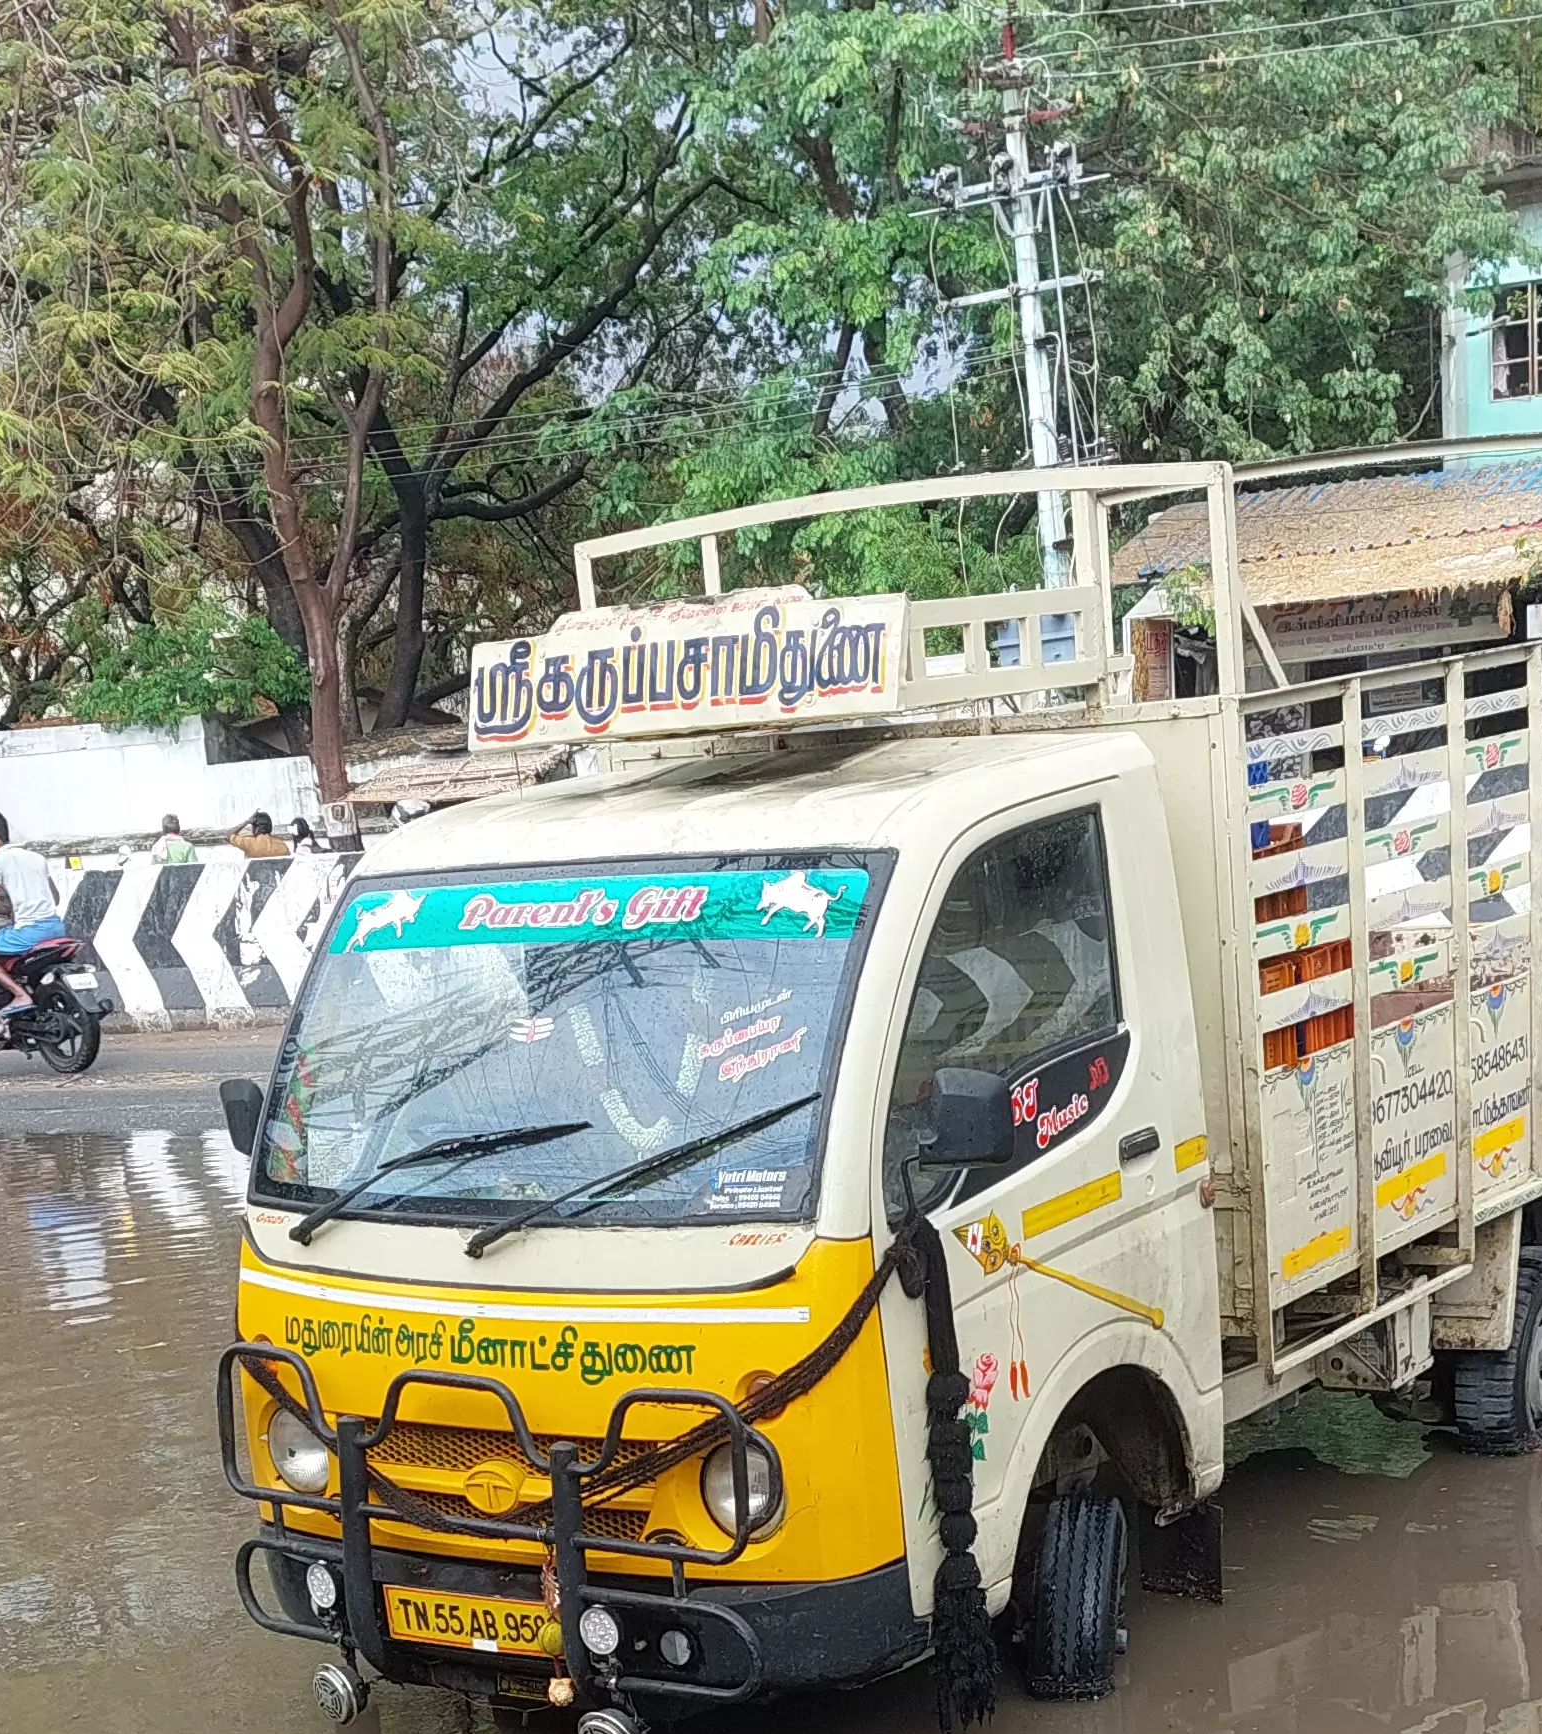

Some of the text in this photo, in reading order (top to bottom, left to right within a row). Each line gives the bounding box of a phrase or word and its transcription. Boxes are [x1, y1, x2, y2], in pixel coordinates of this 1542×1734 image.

[458, 885, 709, 930] Parent's Gift
[1036, 1093, 1089, 1149] Music
[746, 1169, 787, 1183] Motors
[285, 1313, 697, 1386] மதுரையின் அரசி மீனாட்சி துணை
